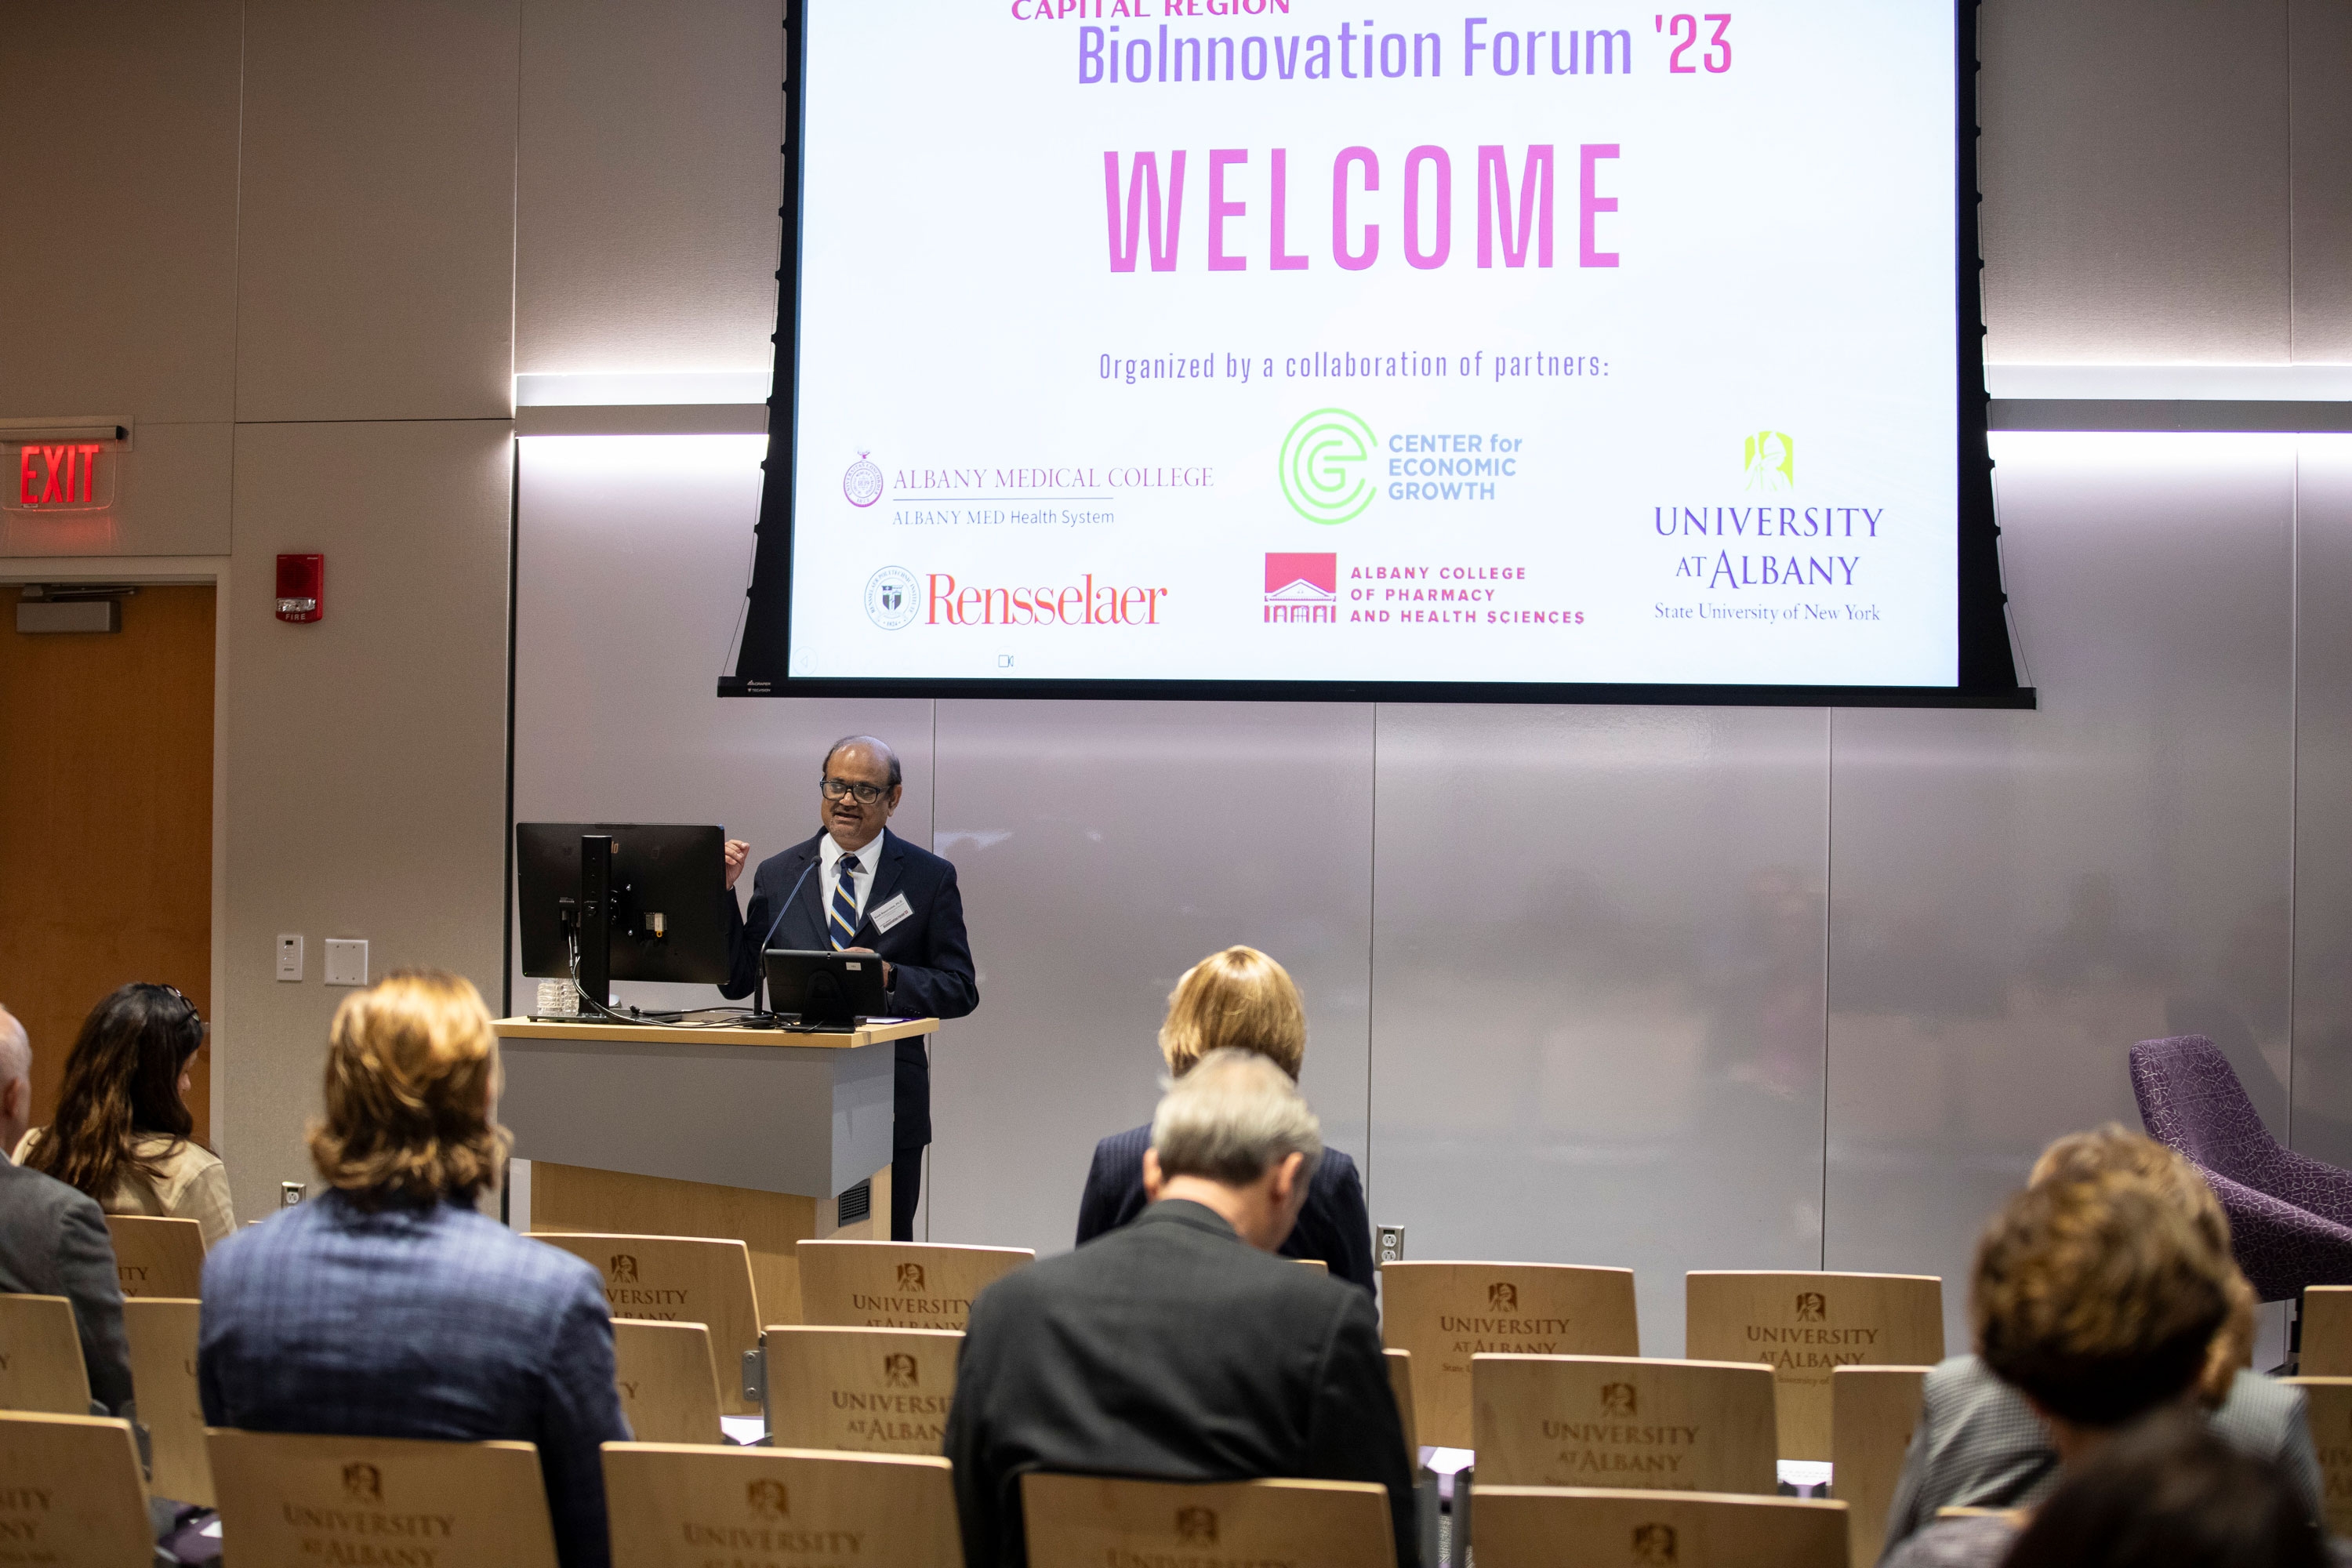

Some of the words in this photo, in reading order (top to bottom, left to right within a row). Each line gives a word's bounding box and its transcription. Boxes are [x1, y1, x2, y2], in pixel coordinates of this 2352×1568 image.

[1011, 0, 1150, 20] CAPITAL
[1165, 0, 1289, 16] REGION
[1079, 20, 1440, 84] BioInnovation
[1465, 17, 1631, 76] Forum
[1655, 13, 1732, 73] '23
[1104, 143, 1620, 273] WELCOME
[1100, 353, 1214, 384] Organized
[1227, 353, 1250, 383] by
[1263, 358, 1273, 377] a
[1287, 351, 1446, 377] collaboration
[1460, 350, 1483, 376] of
[1496, 351, 1608, 382] partners:
[1389, 434, 1483, 452] CENTER
[1490, 434, 1523, 452] for
[20, 444, 99, 503] EXIT
[1389, 458, 1516, 476] ECONOMIC
[893, 470, 987, 488] ALBANY
[995, 469, 1101, 488] MEDICAL
[1109, 468, 1214, 487] COLLEGE
[1388, 481, 1495, 500] GROWTH
[892, 510, 961, 524] ALBANY
[967, 510, 1005, 524] MED
[1011, 510, 1057, 524] Health
[1062, 510, 1114, 528] System
[1655, 507, 1884, 536] UNIVERSITY
[1351, 567, 1429, 579] ALBANY
[1439, 567, 1526, 579] COLLEGE
[1675, 557, 1707, 576] AT
[1706, 549, 1860, 589] ALBANY
[925, 573, 1167, 625] Rensselaer
[1351, 589, 1374, 601] OF
[1385, 589, 1495, 601] PHARMACY
[1351, 610, 1390, 622] AND
[1401, 610, 1476, 623] HEALTH
[1487, 611, 1584, 624] SCIENCES
[1655, 603, 1693, 619] State
[1699, 603, 1778, 624] University
[1783, 603, 1801, 620] of
[1805, 604, 1840, 619] New
[1845, 604, 1881, 620] York
[606, 1289, 688, 1304] VERSITY
[853, 1294, 975, 1314] UNIVERSITY
[1440, 1316, 1570, 1334] UNIVERSITY
[1747, 1325, 1878, 1345] UNIVERSITY
[1453, 1341, 1471, 1352] AT
[1759, 1351, 1777, 1362] AT
[1778, 1348, 1864, 1369] ALBANY
[832, 1392, 949, 1413] UNIVERSI
[866, 1417, 946, 1441] ALBAN
[1542, 1420, 1700, 1445] UNIVERSITY
[1578, 1450, 1683, 1472] ALBANY
[283, 1502, 456, 1537] UNIVERSITY
